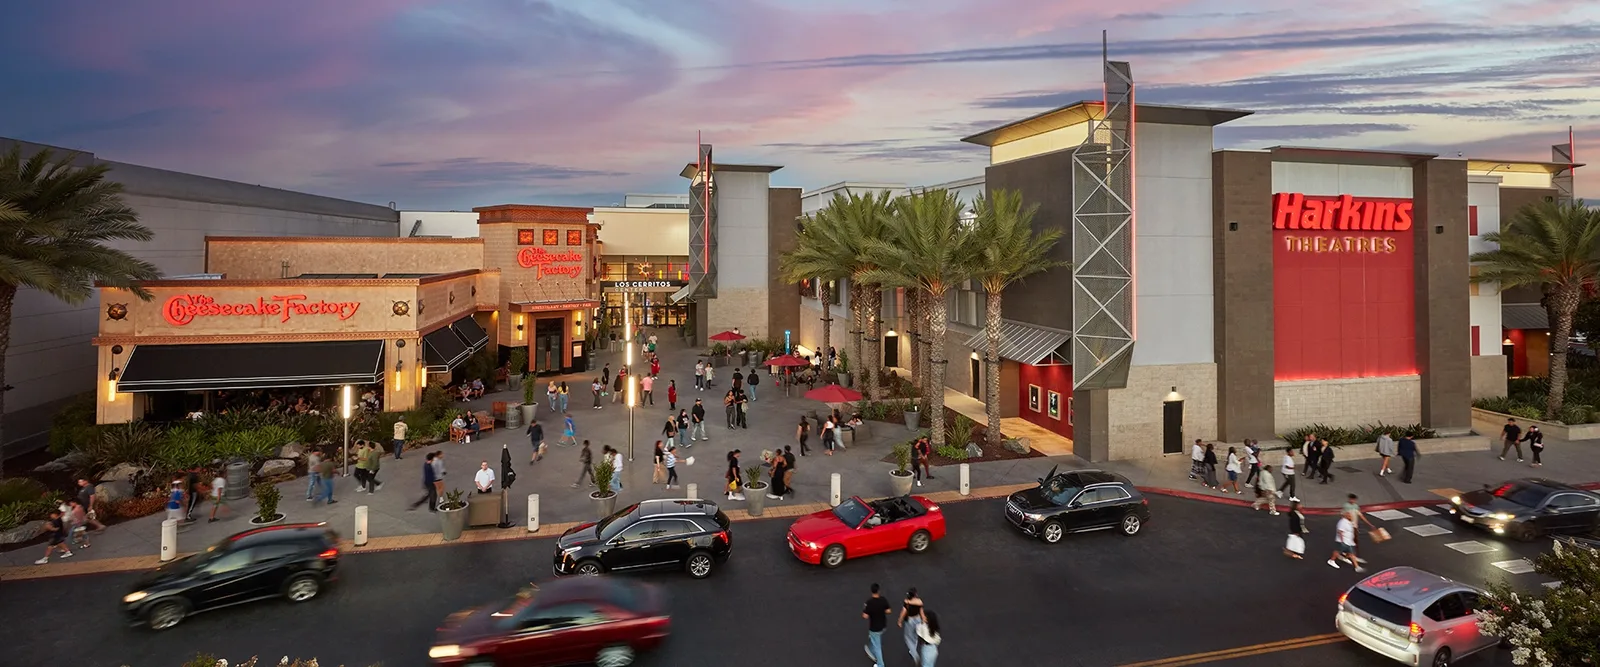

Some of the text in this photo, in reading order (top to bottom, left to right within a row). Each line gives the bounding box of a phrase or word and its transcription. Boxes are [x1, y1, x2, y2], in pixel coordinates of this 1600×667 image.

[1273, 193, 1413, 230] Harkins
[1285, 236, 1396, 253] THEATRES
[517, 247, 582, 268] Cheesecake
[532, 261, 582, 281] Factory
[188, 294, 214, 304] The
[162, 294, 361, 326] Cheesecake Factory
